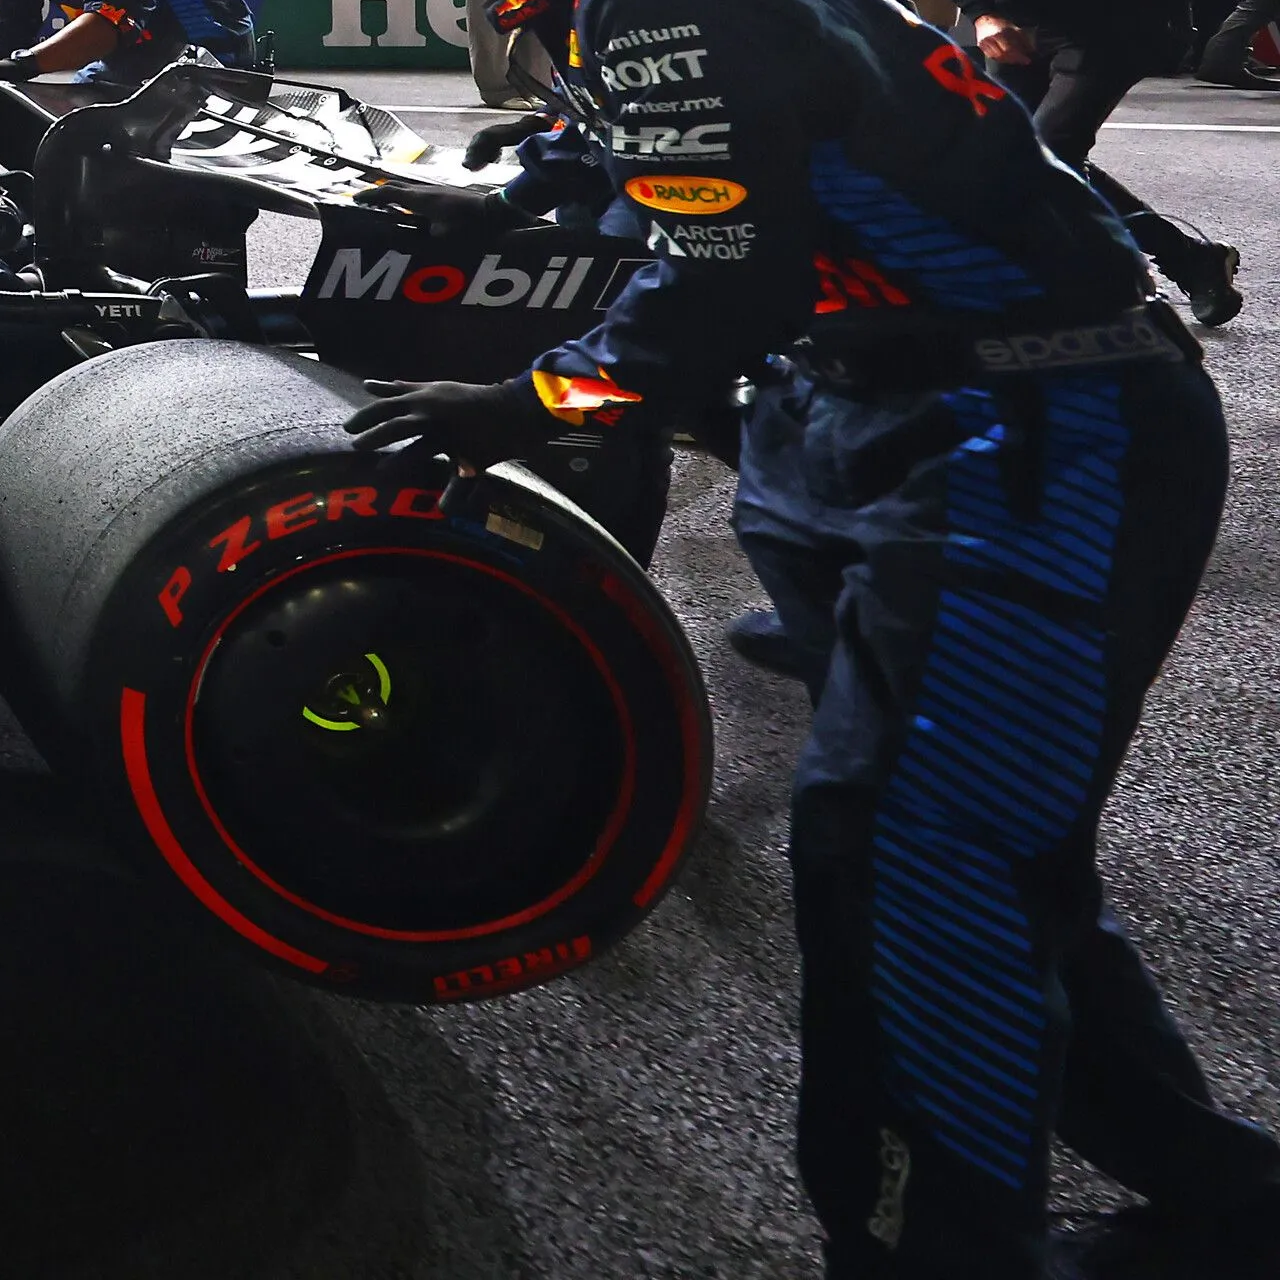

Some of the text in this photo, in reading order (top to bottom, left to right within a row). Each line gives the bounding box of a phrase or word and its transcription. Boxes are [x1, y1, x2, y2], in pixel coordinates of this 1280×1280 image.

[612, 123, 731, 154] HRC
[654, 184, 730, 203] RAUCH
[673, 223, 756, 240] ARCTIC
[687, 241, 751, 260] WOLF
[317, 247, 592, 310] Mobil
[94, 304, 142, 318] YETI
[158, 486, 447, 628] P ZERO
